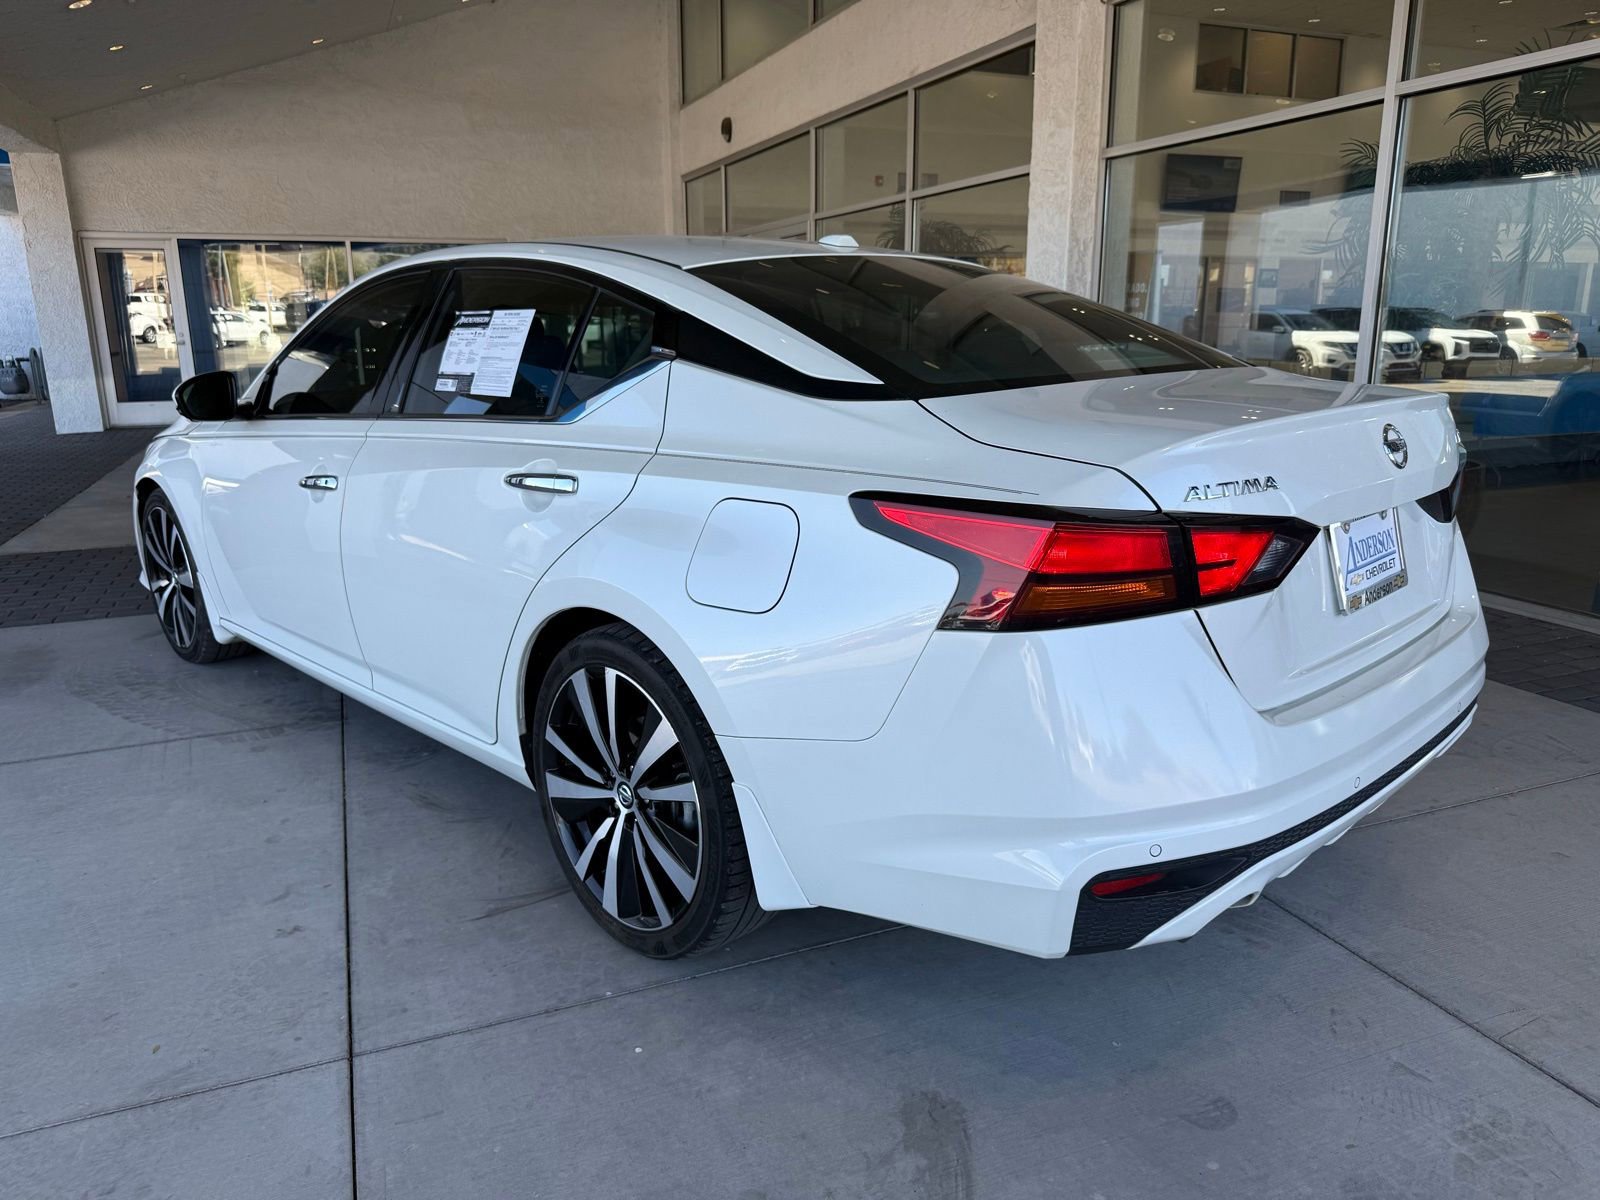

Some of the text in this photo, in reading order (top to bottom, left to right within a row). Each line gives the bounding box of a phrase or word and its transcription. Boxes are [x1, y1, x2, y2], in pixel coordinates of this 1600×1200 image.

[1183, 475, 1280, 502] ALTIMA
[1345, 528, 1395, 591] ANDERSON
[1365, 557, 1396, 580] CHEVROLET
[1364, 581, 1394, 606] Anderson
